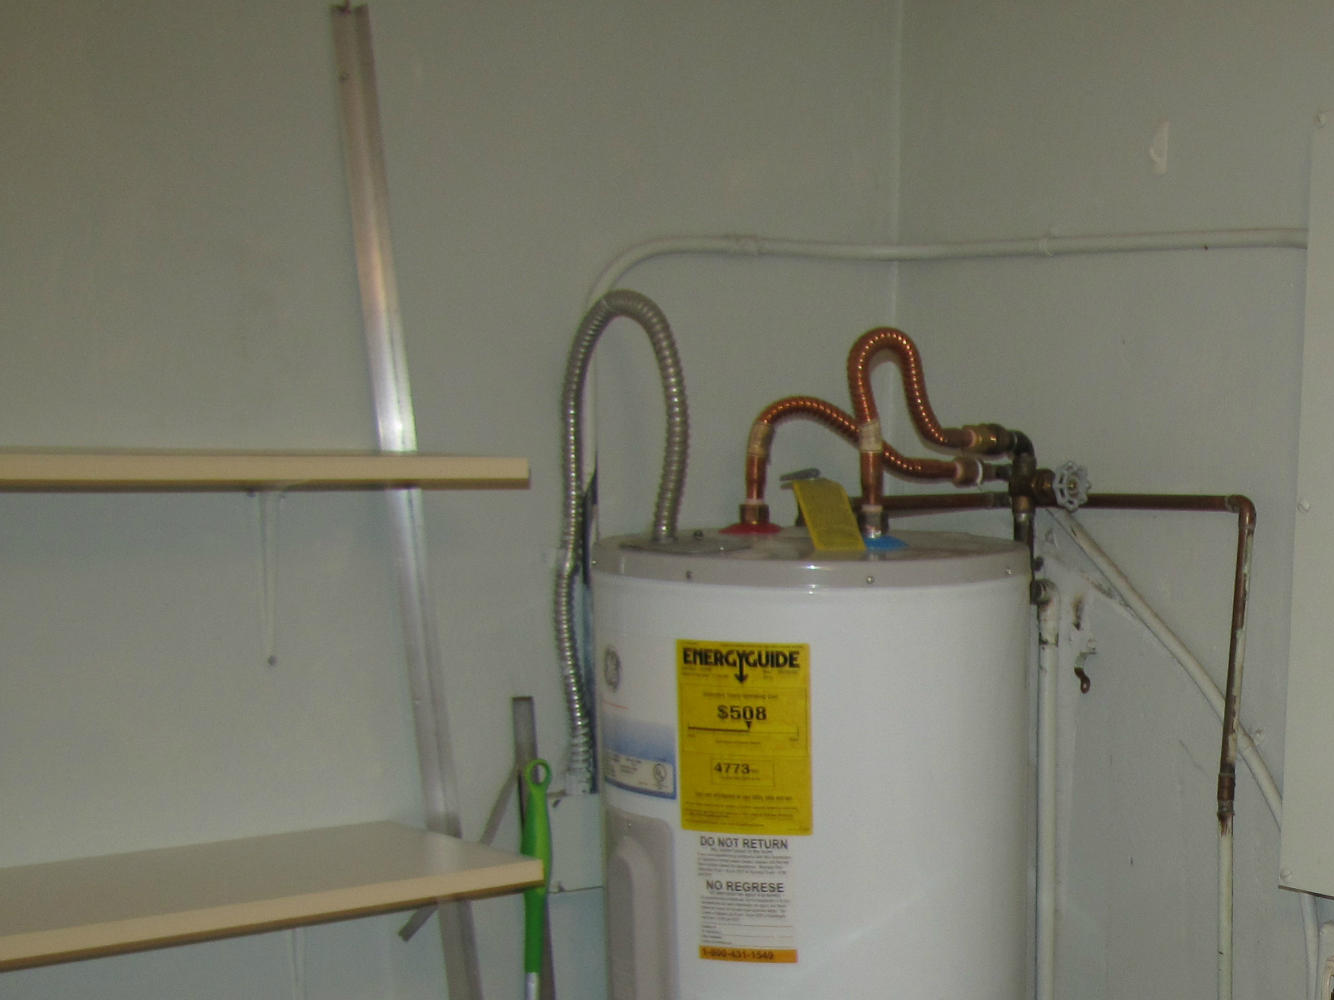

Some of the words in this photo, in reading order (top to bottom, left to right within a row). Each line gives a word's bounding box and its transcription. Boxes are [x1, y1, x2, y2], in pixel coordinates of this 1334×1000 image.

[682, 647, 801, 669] ENERGYGUIDE
[717, 704, 768, 721] $508
[713, 761, 751, 775] 4773
[700, 836, 715, 847] DO
[717, 837, 739, 848] NOT
[743, 838, 789, 850] RETURN
[706, 880, 723, 891] NO
[726, 881, 785, 893] REGRESE
